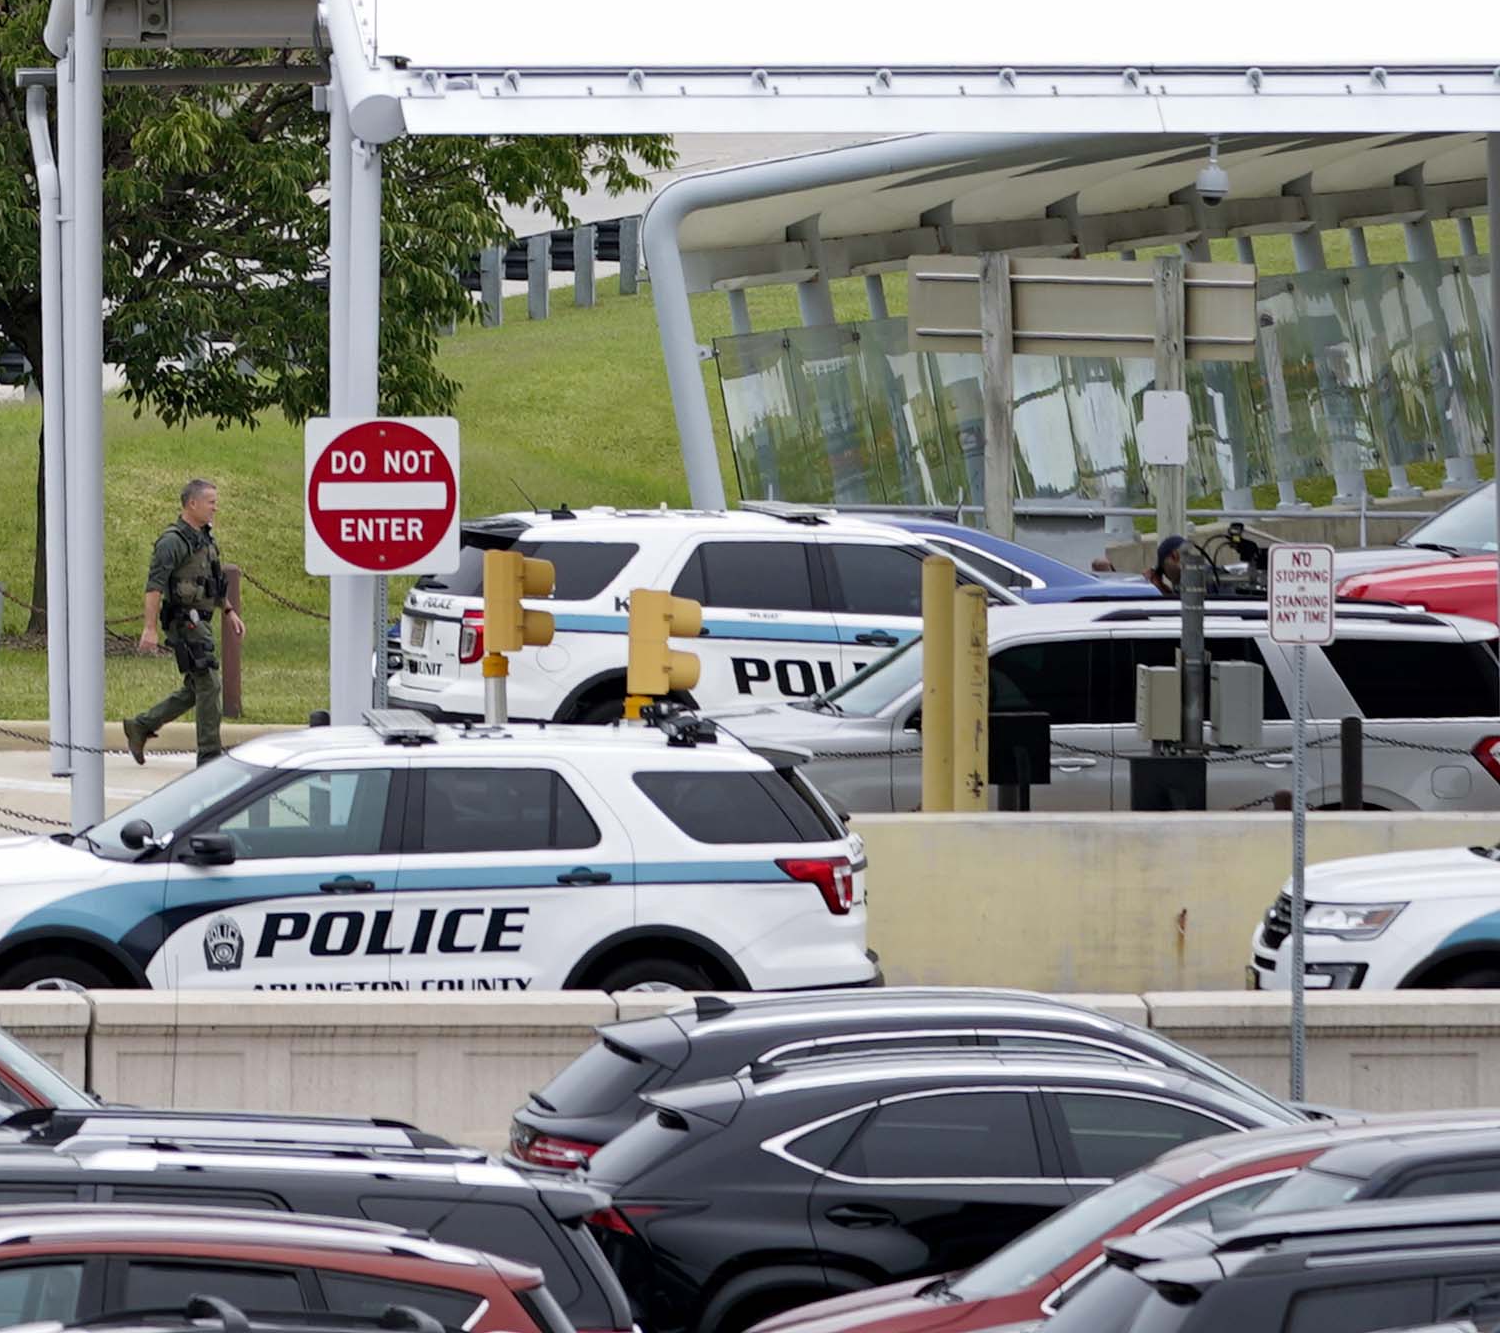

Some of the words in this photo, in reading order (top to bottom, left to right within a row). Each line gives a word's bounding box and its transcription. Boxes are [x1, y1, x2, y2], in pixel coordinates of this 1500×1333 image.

[330, 450, 367, 475] DO
[383, 449, 435, 475] NOT
[340, 517, 424, 543] ENTER
[1291, 551, 1312, 567] NO
[1275, 570, 1329, 583] STOPPING
[1275, 595, 1329, 608] STANDING
[1275, 611, 1298, 623] ANY
[1302, 610, 1328, 623] TIME
[254, 906, 530, 958] POLICE
